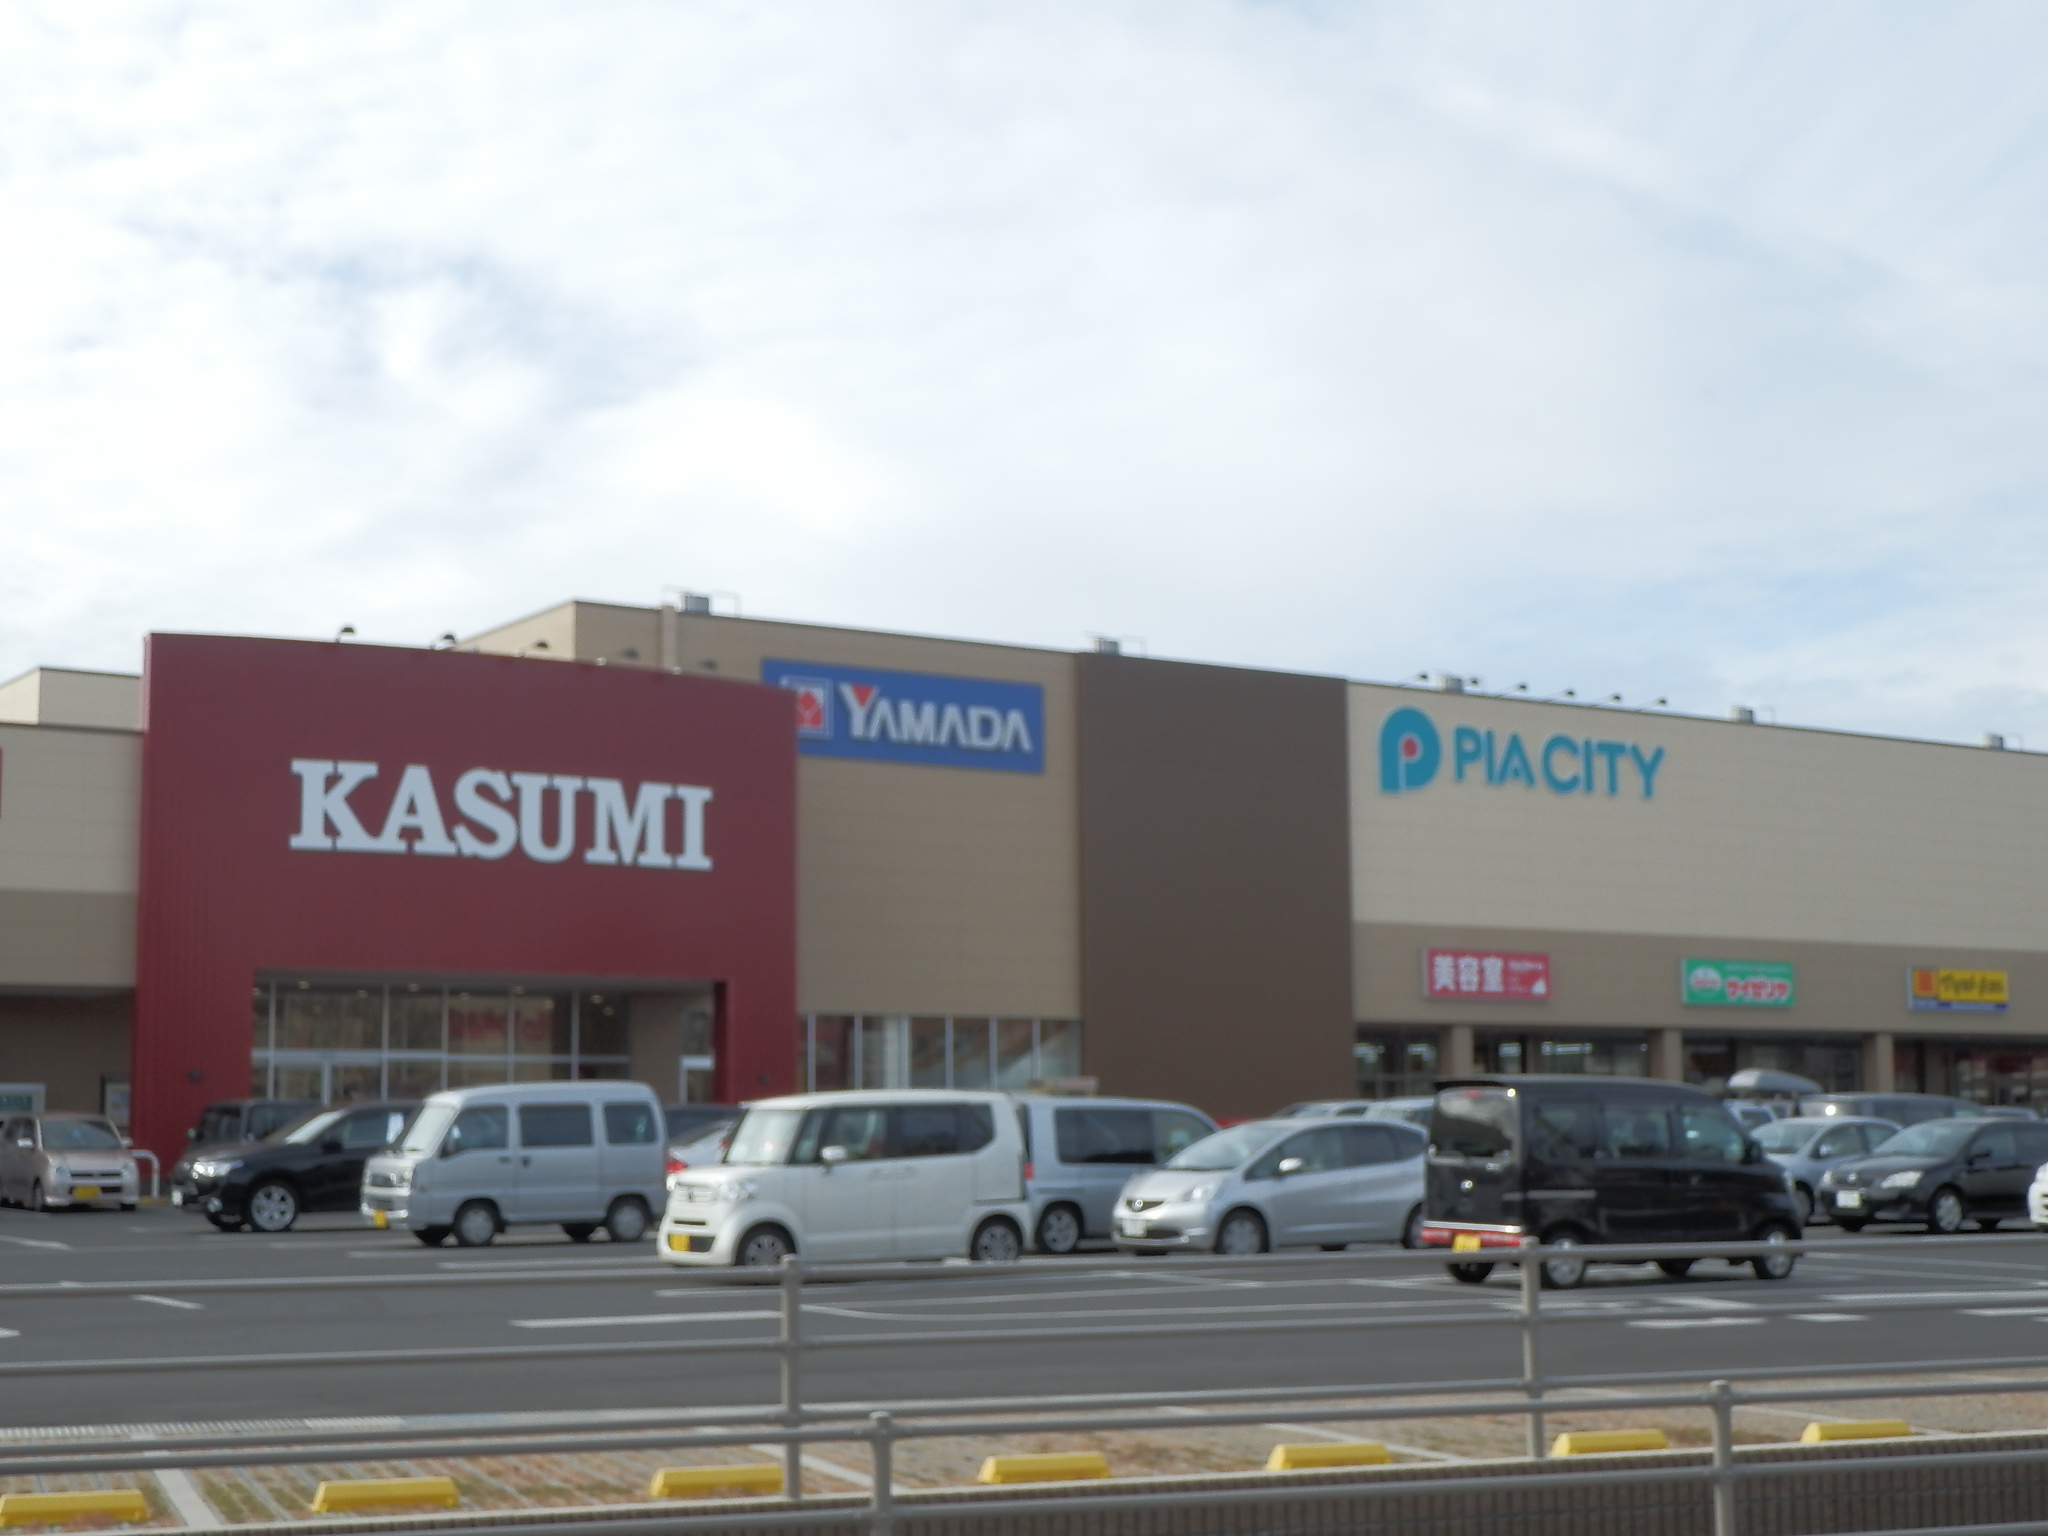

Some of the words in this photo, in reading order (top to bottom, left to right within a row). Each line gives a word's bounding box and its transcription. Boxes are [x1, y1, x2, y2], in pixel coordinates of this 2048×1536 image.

[839, 682, 1034, 754] YAMADA
[288, 757, 713, 871] KASUMI
[1433, 955, 1504, 992] 美容室
